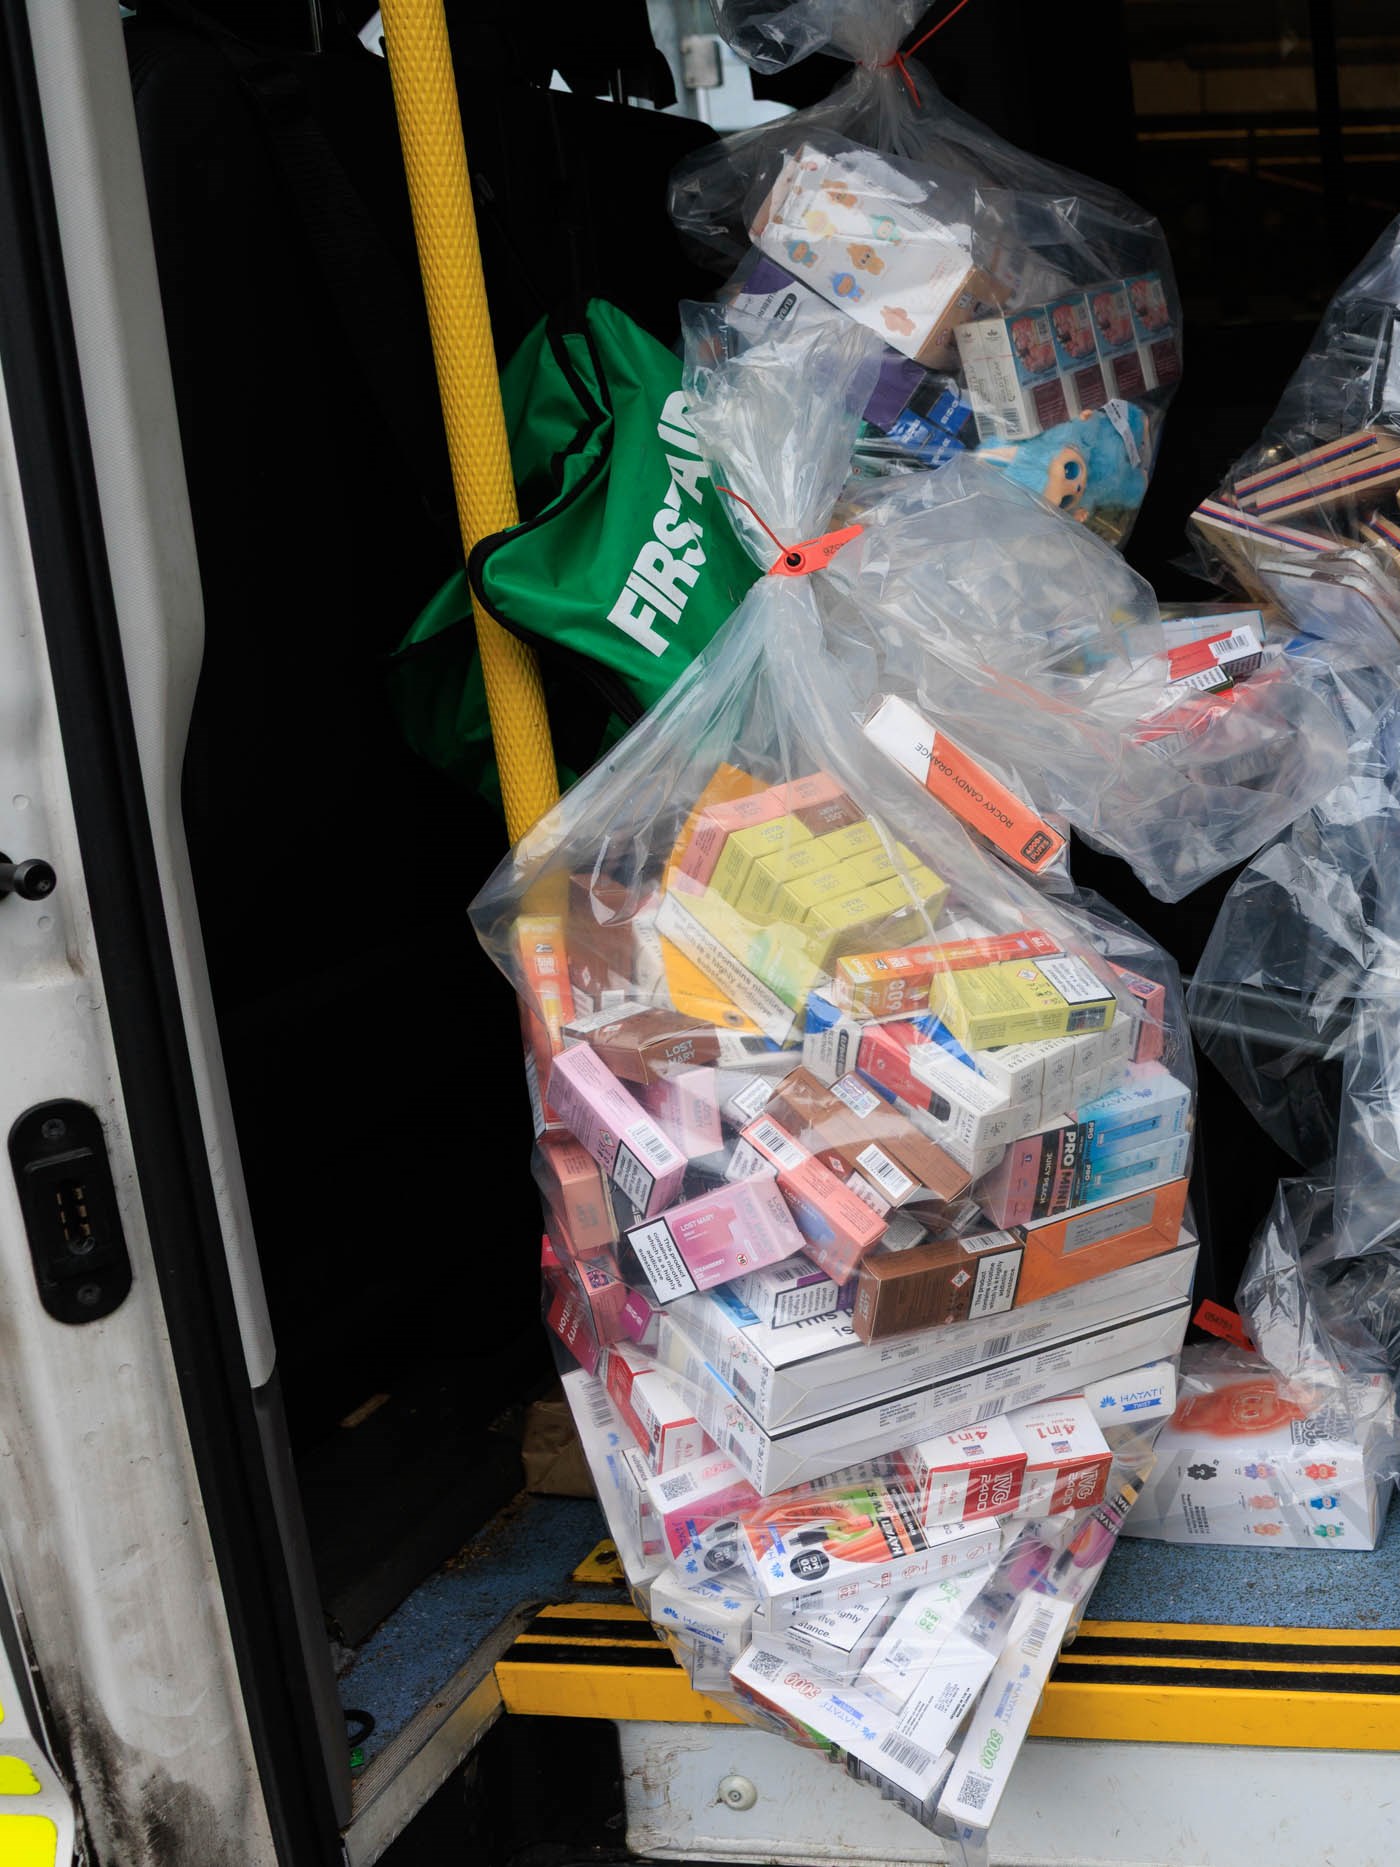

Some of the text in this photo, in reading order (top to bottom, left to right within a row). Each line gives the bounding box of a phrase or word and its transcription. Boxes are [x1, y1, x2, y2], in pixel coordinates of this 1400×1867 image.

[606, 477, 707, 658] FIRST
[914, 742, 1015, 830] ROCKY CANDY ORANGE
[1031, 839, 1050, 861] PUFFS
[665, 1039, 694, 1058] LOST
[1087, 1120, 1096, 1141] PRO
[1063, 1130, 1077, 1168] PRO
[1084, 1163, 1092, 1182] PRO
[637, 1247, 659, 1287] substance.
[645, 1249, 664, 1282] addictive
[646, 1233, 661, 1258] which
[662, 1268, 678, 1292] highly
[652, 1231, 684, 1288] contains nicotine
[663, 1237, 686, 1280] This product
[986, 1262, 996, 1288] nicotine
[978, 1270, 987, 1293] product
[1119, 1386, 1164, 1402] HAYATI
[879, 1517, 904, 1556] HAYATI
[800, 1559, 811, 1573] 20
